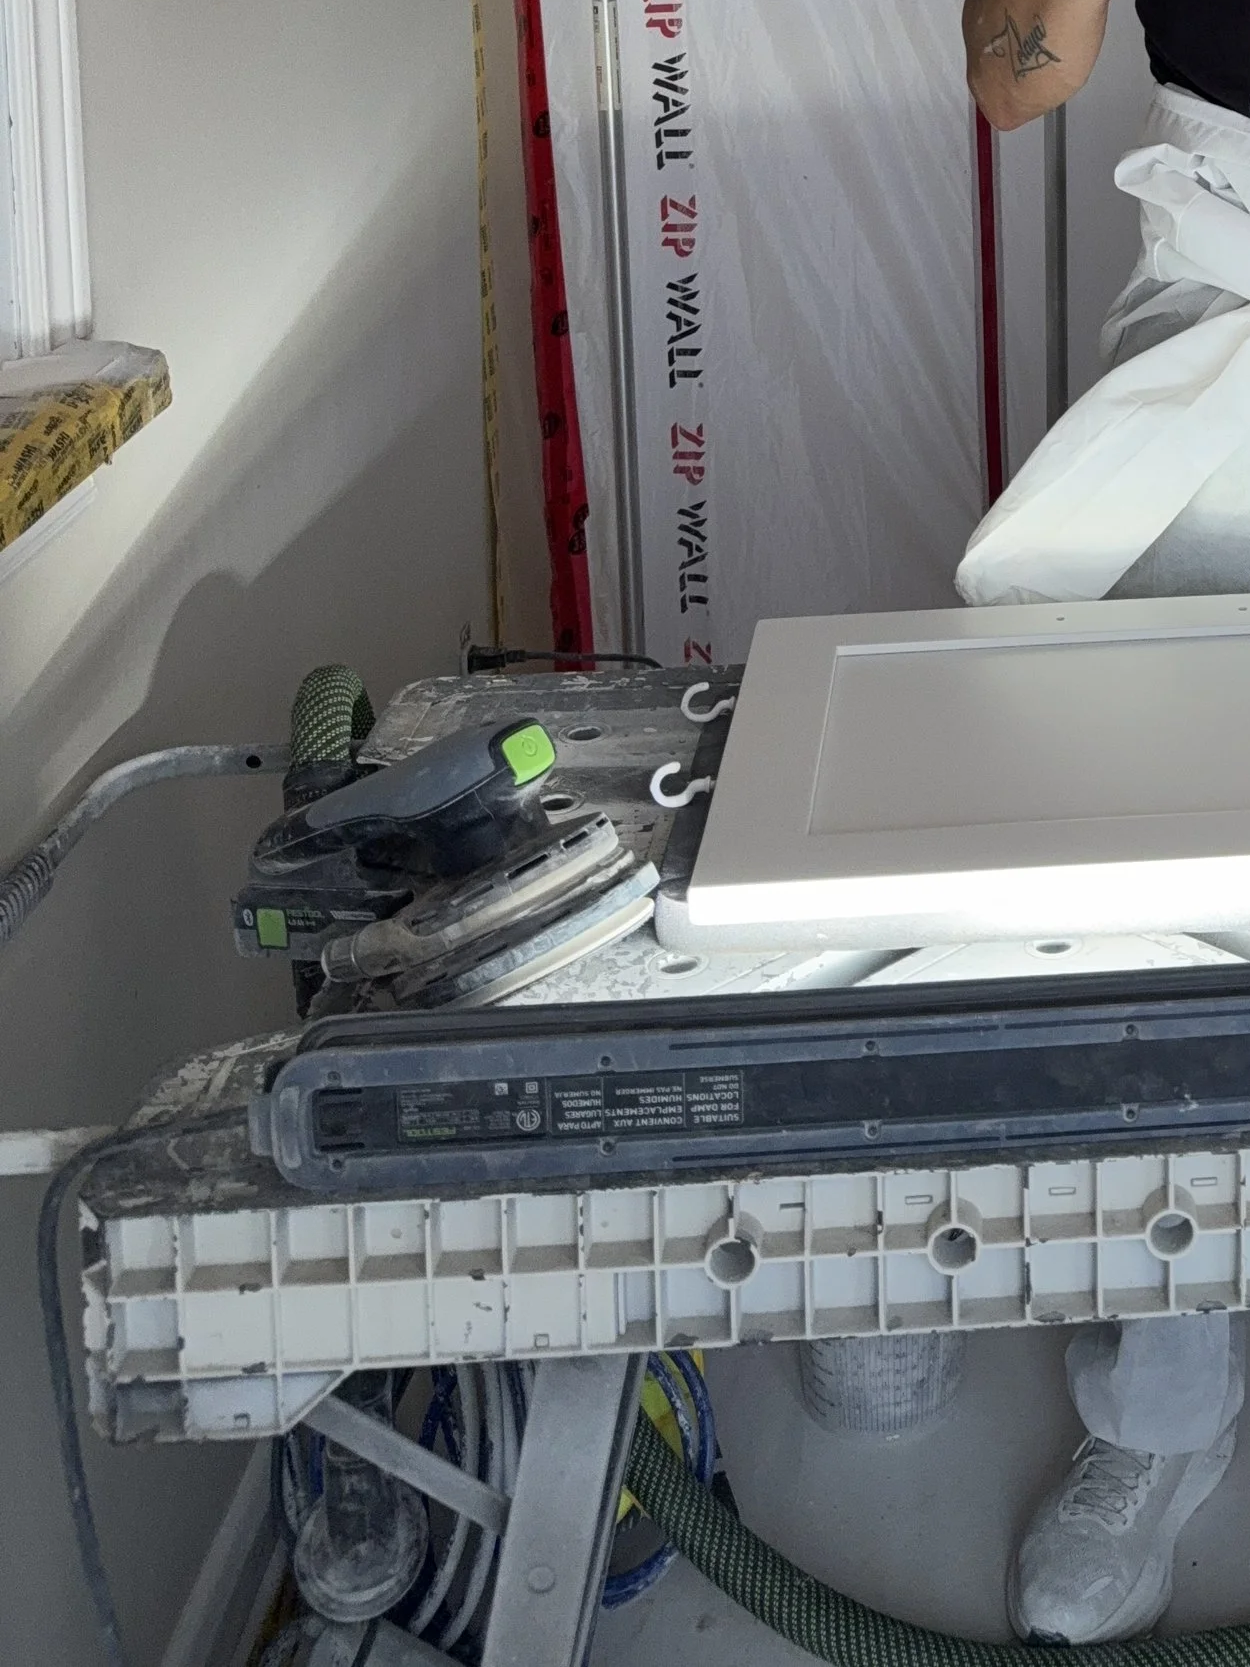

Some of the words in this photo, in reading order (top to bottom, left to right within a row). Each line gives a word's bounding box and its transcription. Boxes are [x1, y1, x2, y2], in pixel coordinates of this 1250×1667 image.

[651, 52, 692, 170] WALL
[660, 195, 698, 258] ZIP
[665, 272, 704, 389] WALL
[670, 422, 705, 486] ZIP
[676, 500, 711, 617] WALL
[639, 1095, 682, 1104] HUMIDES
[686, 1091, 739, 1101] LOCATIONS
[604, 1105, 683, 1117] EMPLACEMENTS
[690, 1103, 720, 1112] DAMP
[722, 1103, 740, 1111] FOR
[613, 1119, 635, 1128] AUX
[635, 1116, 683, 1126] CONVIENT
[693, 1114, 740, 1124] SUITABLE
